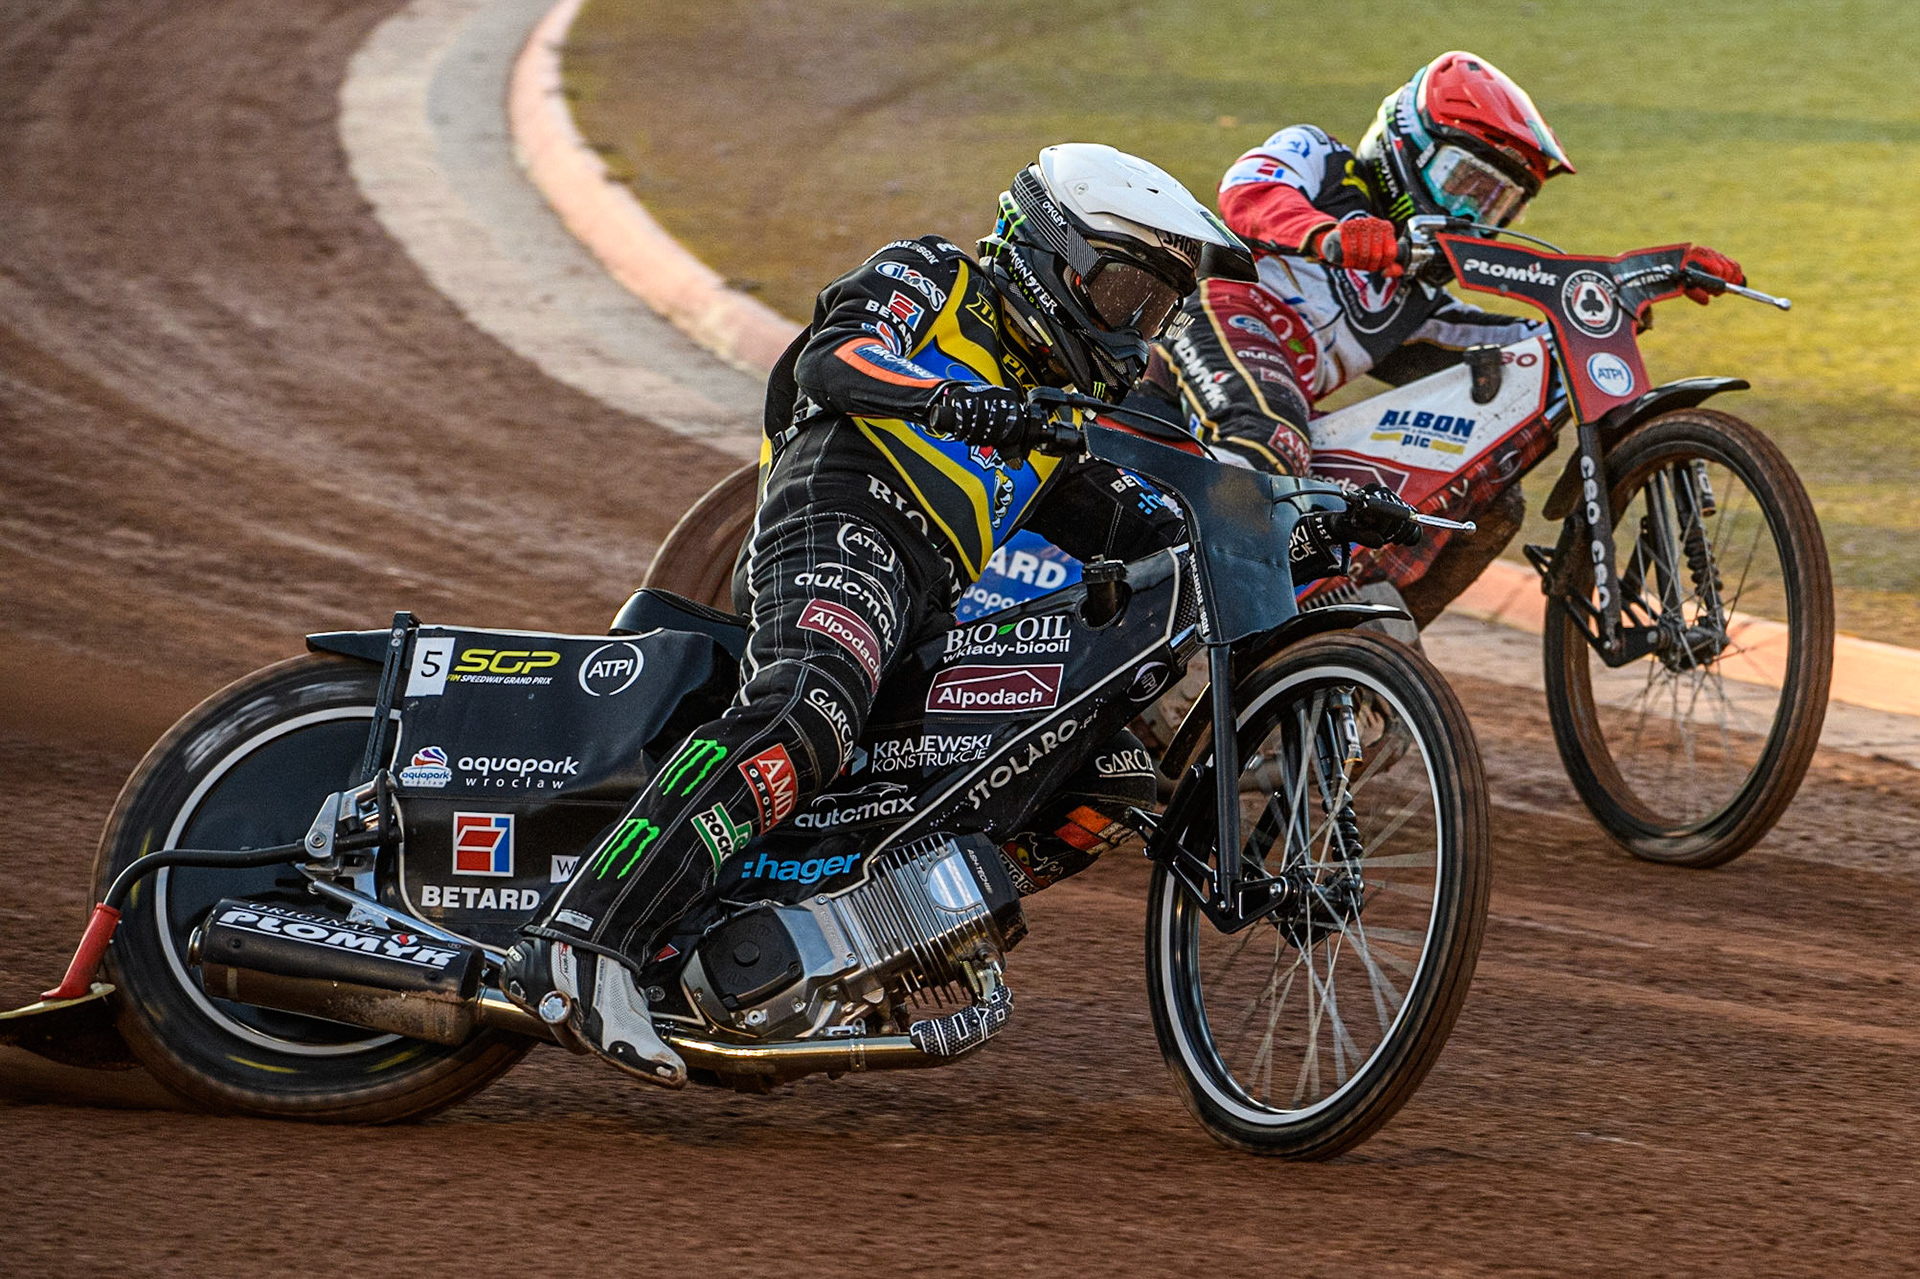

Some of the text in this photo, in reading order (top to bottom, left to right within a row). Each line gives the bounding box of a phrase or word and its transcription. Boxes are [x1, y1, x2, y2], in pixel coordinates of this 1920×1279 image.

[1042, 201, 1067, 227] OAKLEY
[1379, 409, 1475, 437] ALBON
[943, 615, 1071, 654] BIO OIL
[421, 650, 443, 678] 5
[454, 648, 561, 674] SGP
[587, 659, 634, 680] ATPI
[460, 674, 504, 684] SPEEDWAY
[503, 676, 532, 685] GRAND
[532, 677, 553, 685] PRIX
[937, 687, 1043, 708] Alpodach
[873, 734, 992, 760] KRAJEWSKI
[458, 756, 579, 778] aquapark
[871, 749, 987, 774] KONSTRUKCJE
[401, 771, 449, 780] aquapark
[757, 758, 794, 820] AMD
[795, 795, 917, 828] automax
[701, 812, 732, 860] ROCK
[421, 885, 541, 911] BETARD
[249, 903, 377, 934] ORIGINAL
